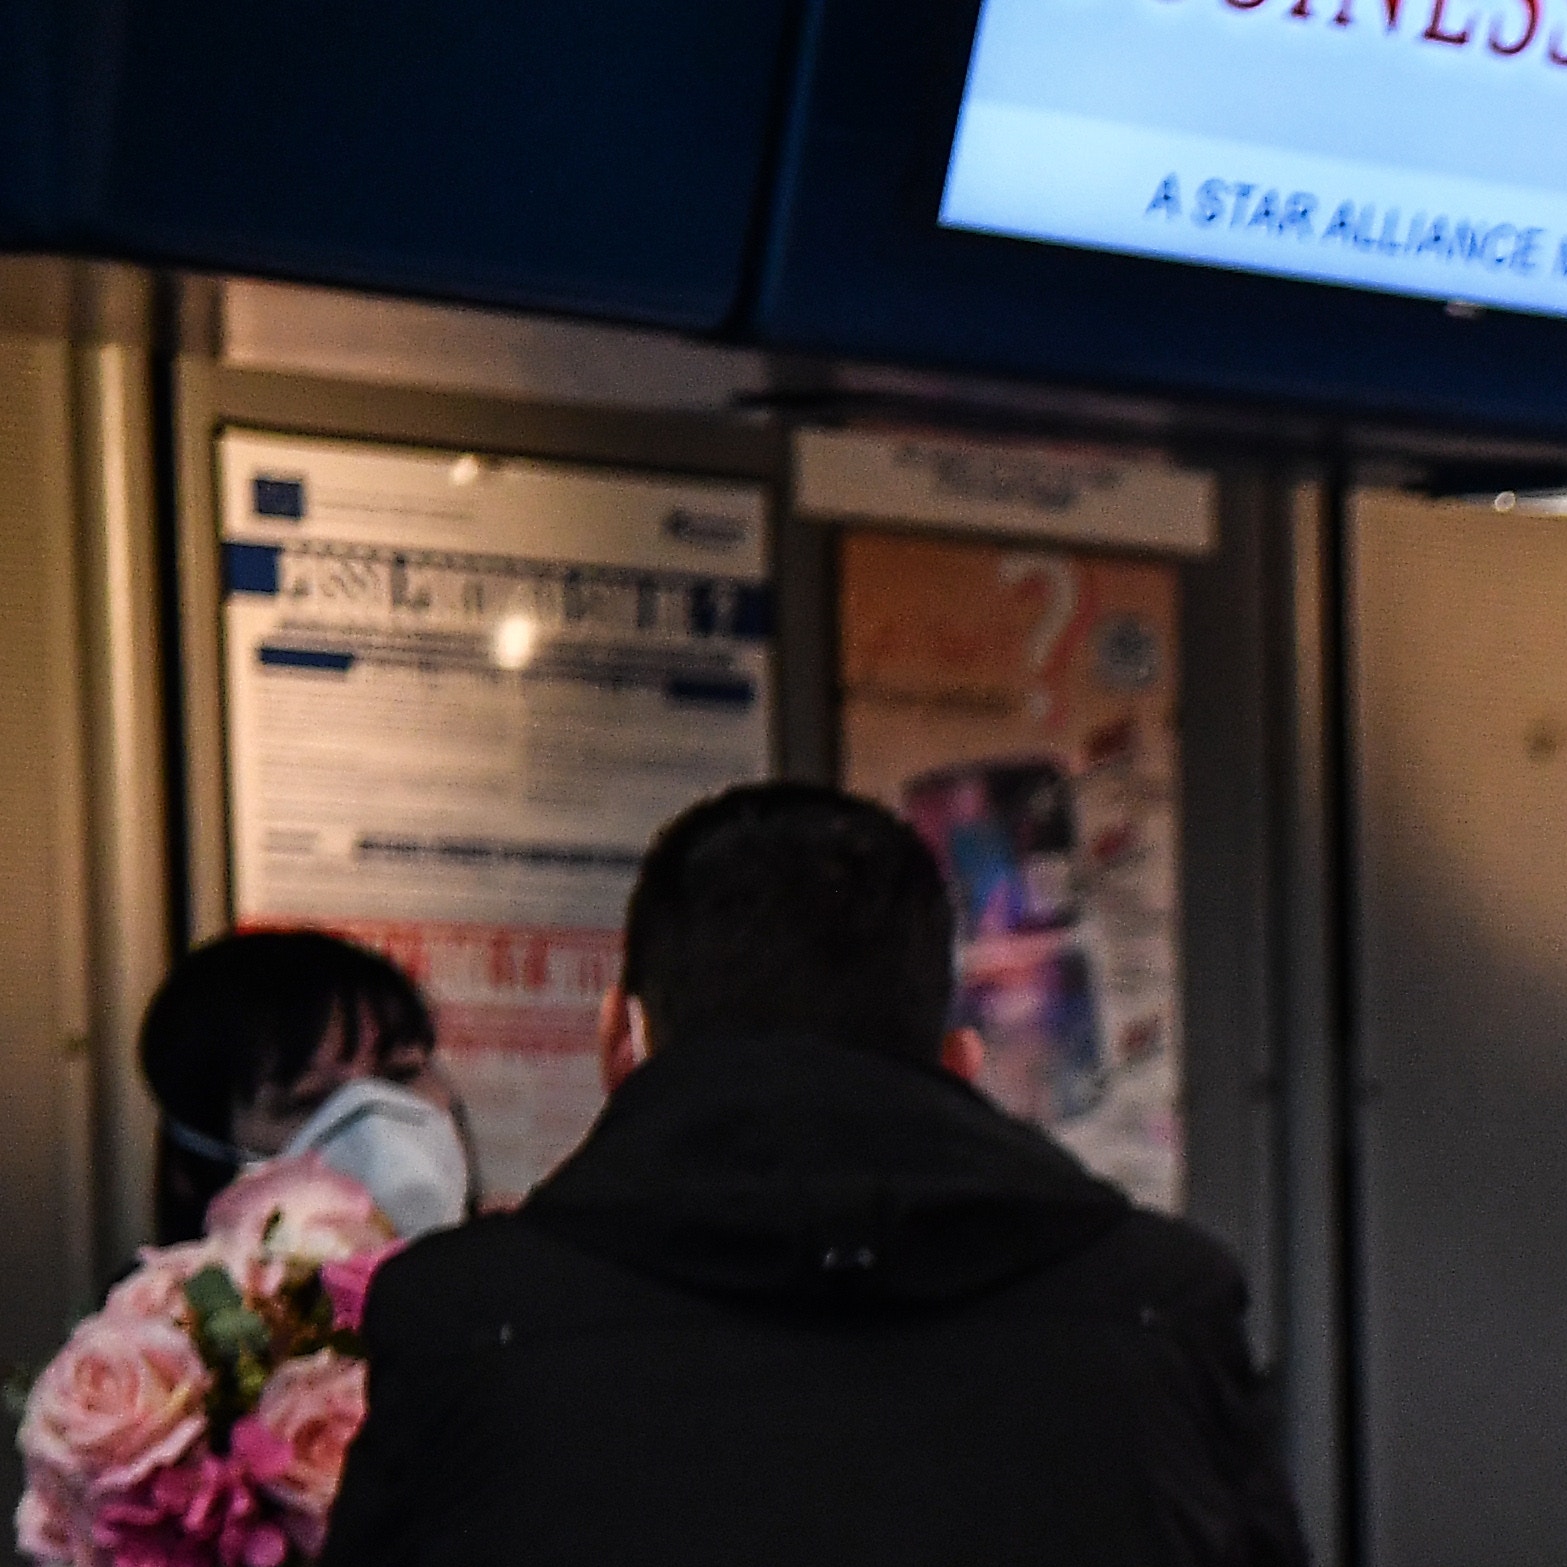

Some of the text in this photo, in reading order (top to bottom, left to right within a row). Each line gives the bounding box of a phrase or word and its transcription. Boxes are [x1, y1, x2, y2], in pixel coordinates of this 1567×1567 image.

[1143, 170, 1182, 221] A
[1193, 177, 1318, 241] STAR
[1322, 198, 1544, 277] ALLIANCE
